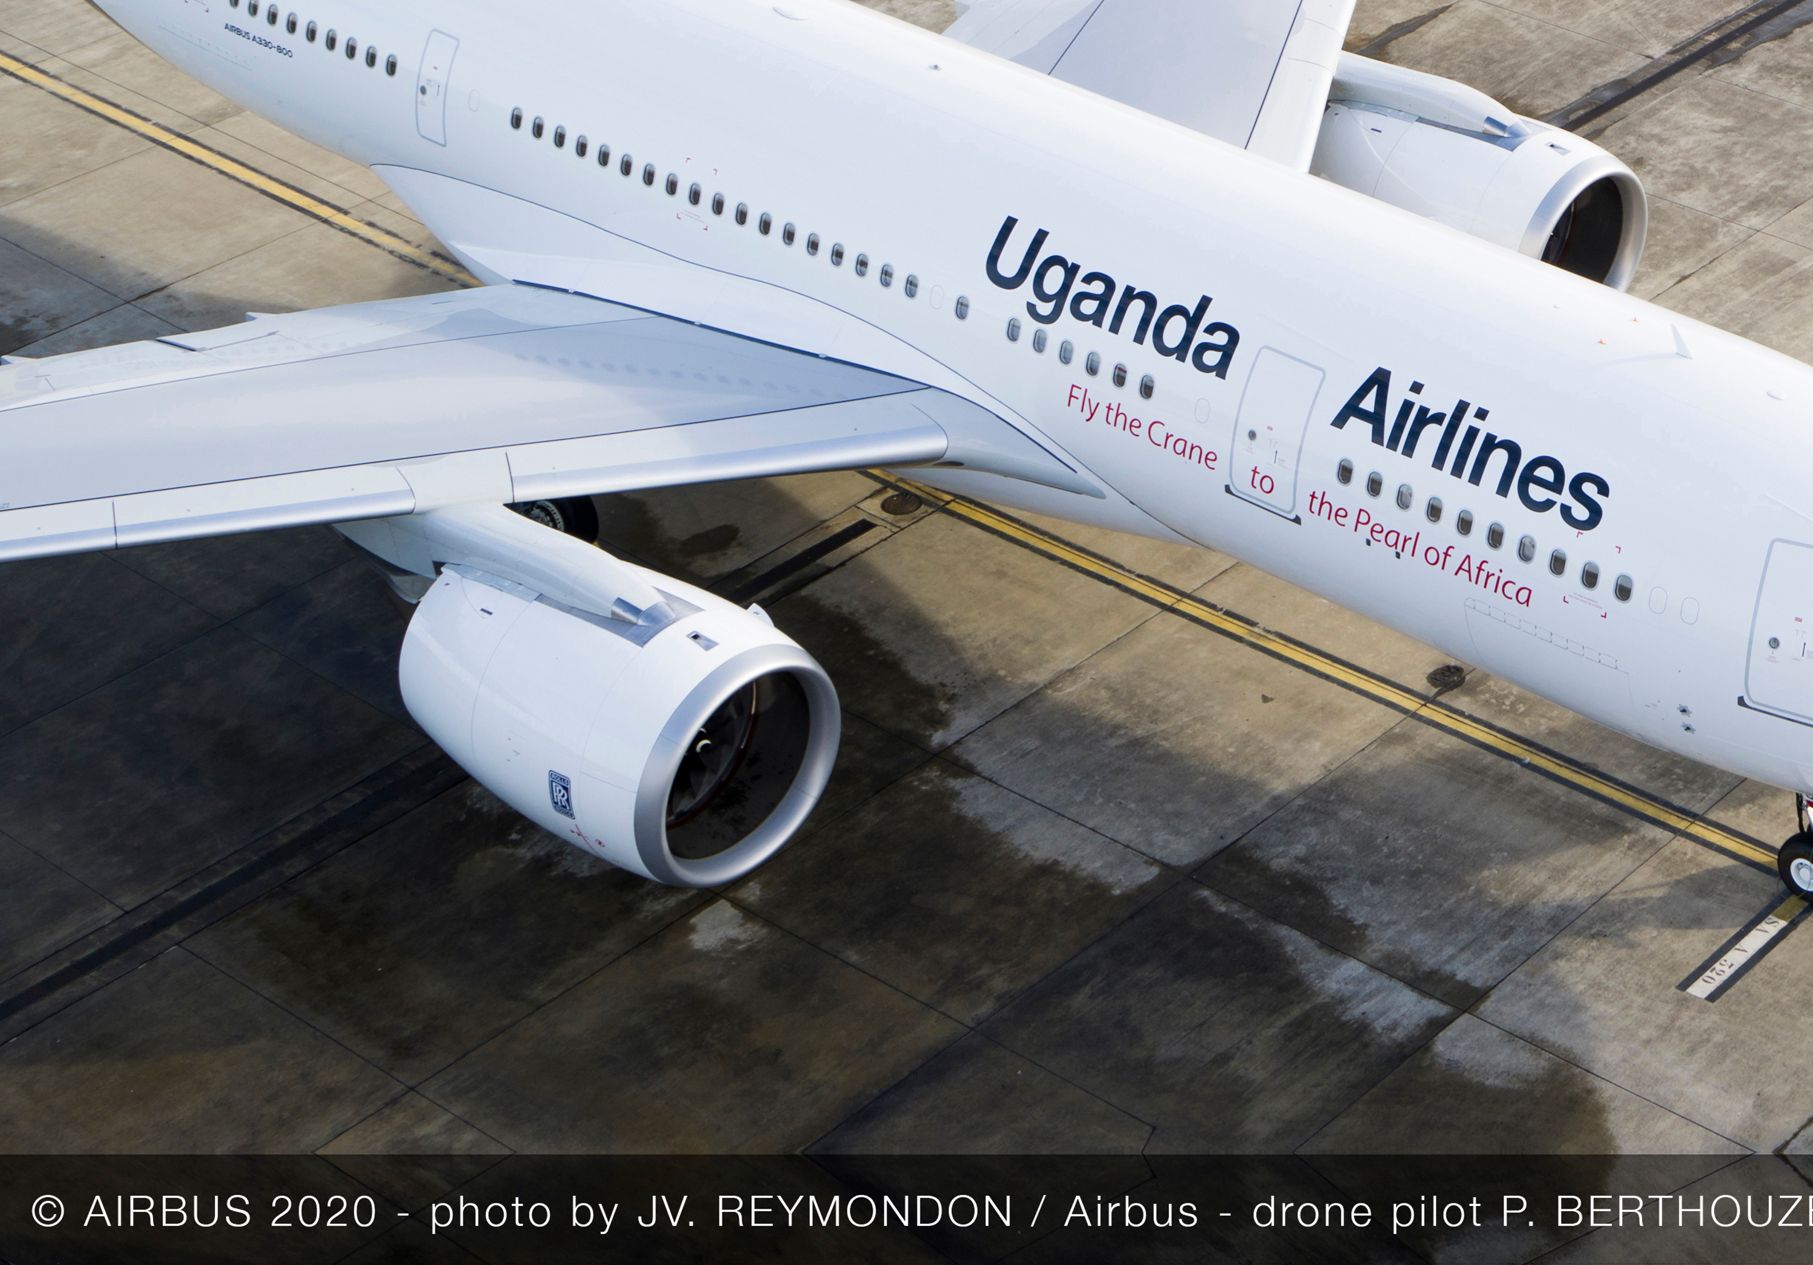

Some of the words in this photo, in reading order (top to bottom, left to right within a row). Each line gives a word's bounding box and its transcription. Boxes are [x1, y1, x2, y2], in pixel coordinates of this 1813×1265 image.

[224, 22, 251, 40] AIRBUS
[251, 35, 293, 58] A330-800
[986, 215, 1240, 380] Uganda
[1330, 366, 1610, 531] Airlines
[1067, 384, 1100, 422] Fly
[1105, 402, 1142, 437] the
[1147, 420, 1218, 470] Crane
[1250, 465, 1275, 494] to
[1309, 490, 1348, 527] the
[1354, 508, 1420, 557] Pearl
[1423, 544, 1456, 571] of
[1454, 554, 1533, 608] Africa
